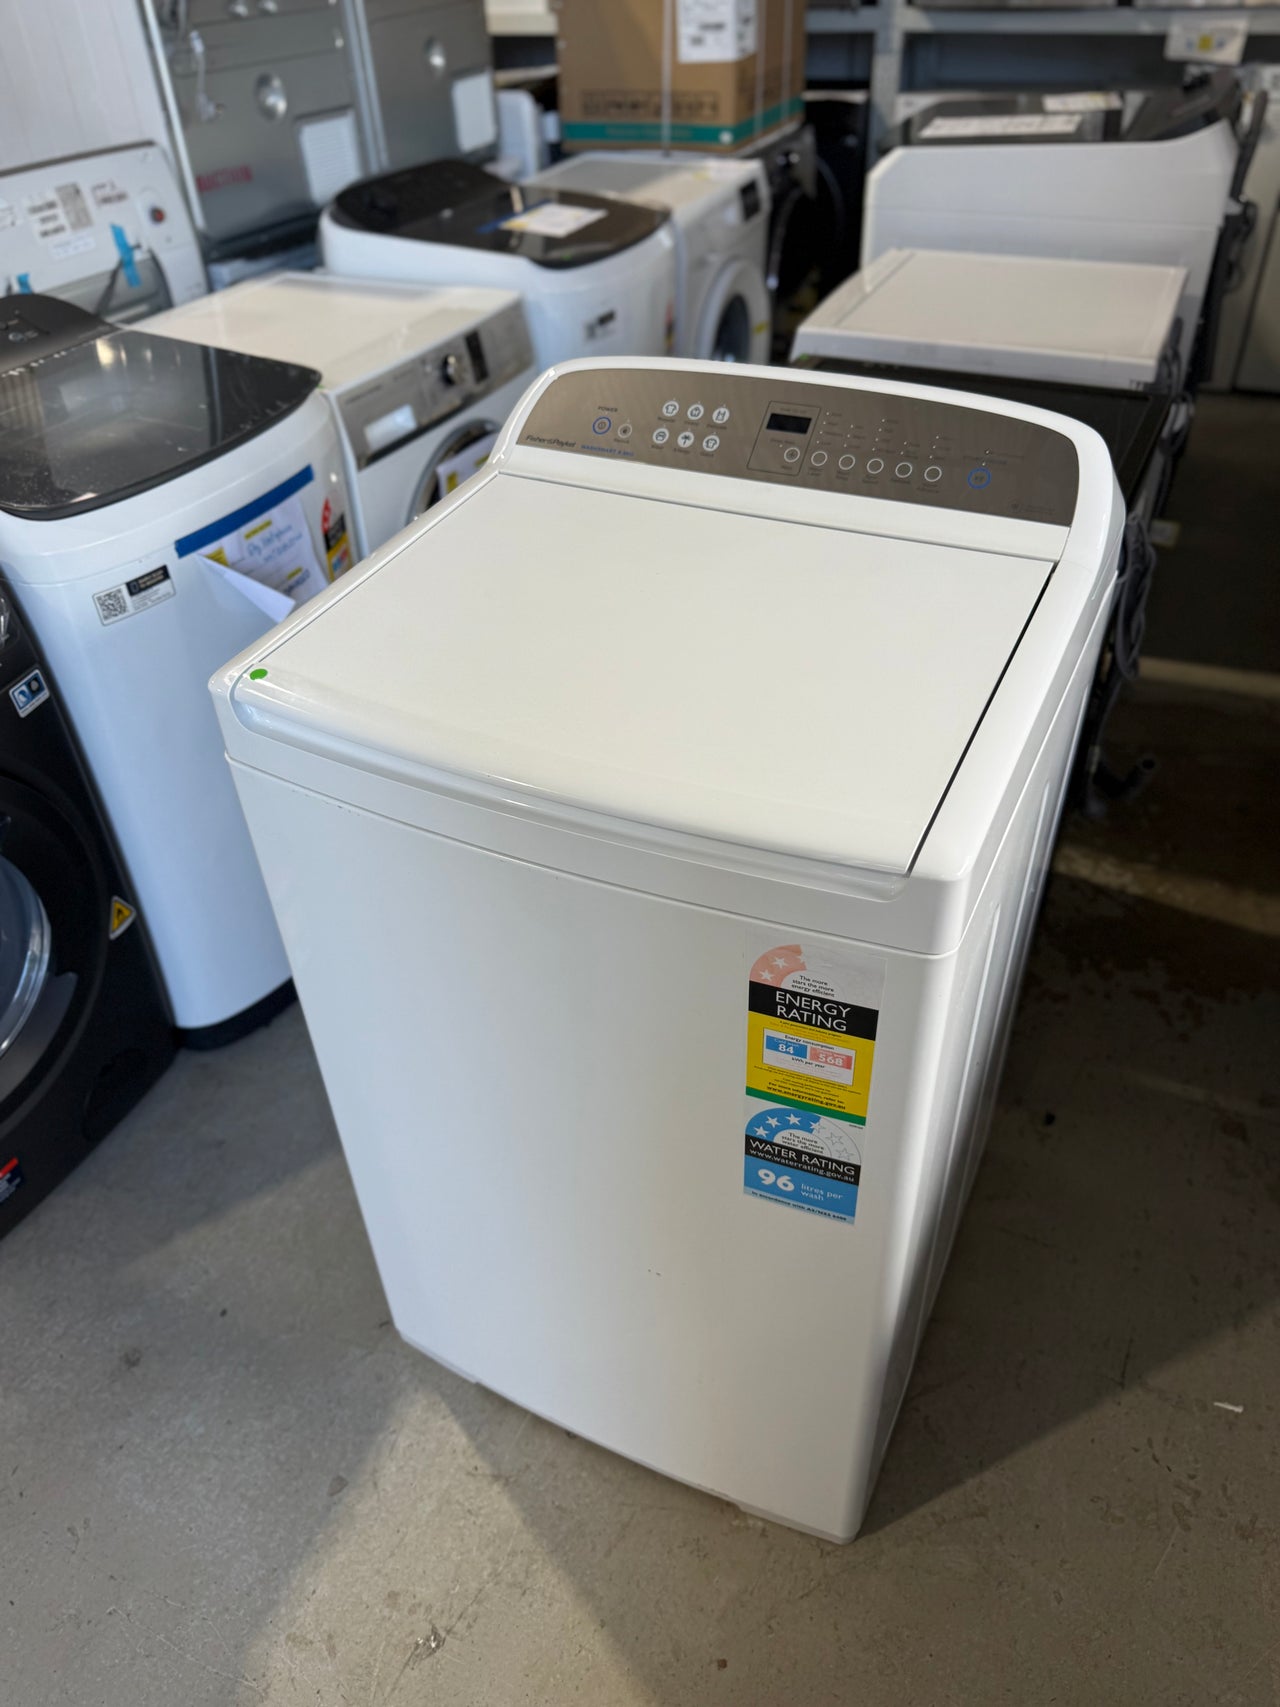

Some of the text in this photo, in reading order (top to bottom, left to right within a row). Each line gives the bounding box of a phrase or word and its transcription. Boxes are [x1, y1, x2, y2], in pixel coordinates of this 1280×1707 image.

[792, 979, 807, 987] stars
[791, 984, 835, 998] energy efficient
[775, 991, 851, 1018] ENERGY
[777, 1005, 847, 1032] RATING
[784, 1034, 802, 1043] Energy
[778, 1043, 794, 1054] 84
[818, 1053, 843, 1066] 568
[767, 1086, 846, 1110] www.energyrating.gov.au
[781, 1135, 825, 1151] stars the more
[788, 1132, 818, 1144] The more
[781, 1139, 824, 1154] water efficient
[749, 1138, 855, 1175] WATER RATING
[749, 1149, 855, 1183] www.waterrating.gov.au
[757, 1168, 844, 1200] 96 litres per
[800, 1190, 824, 1201] wash
